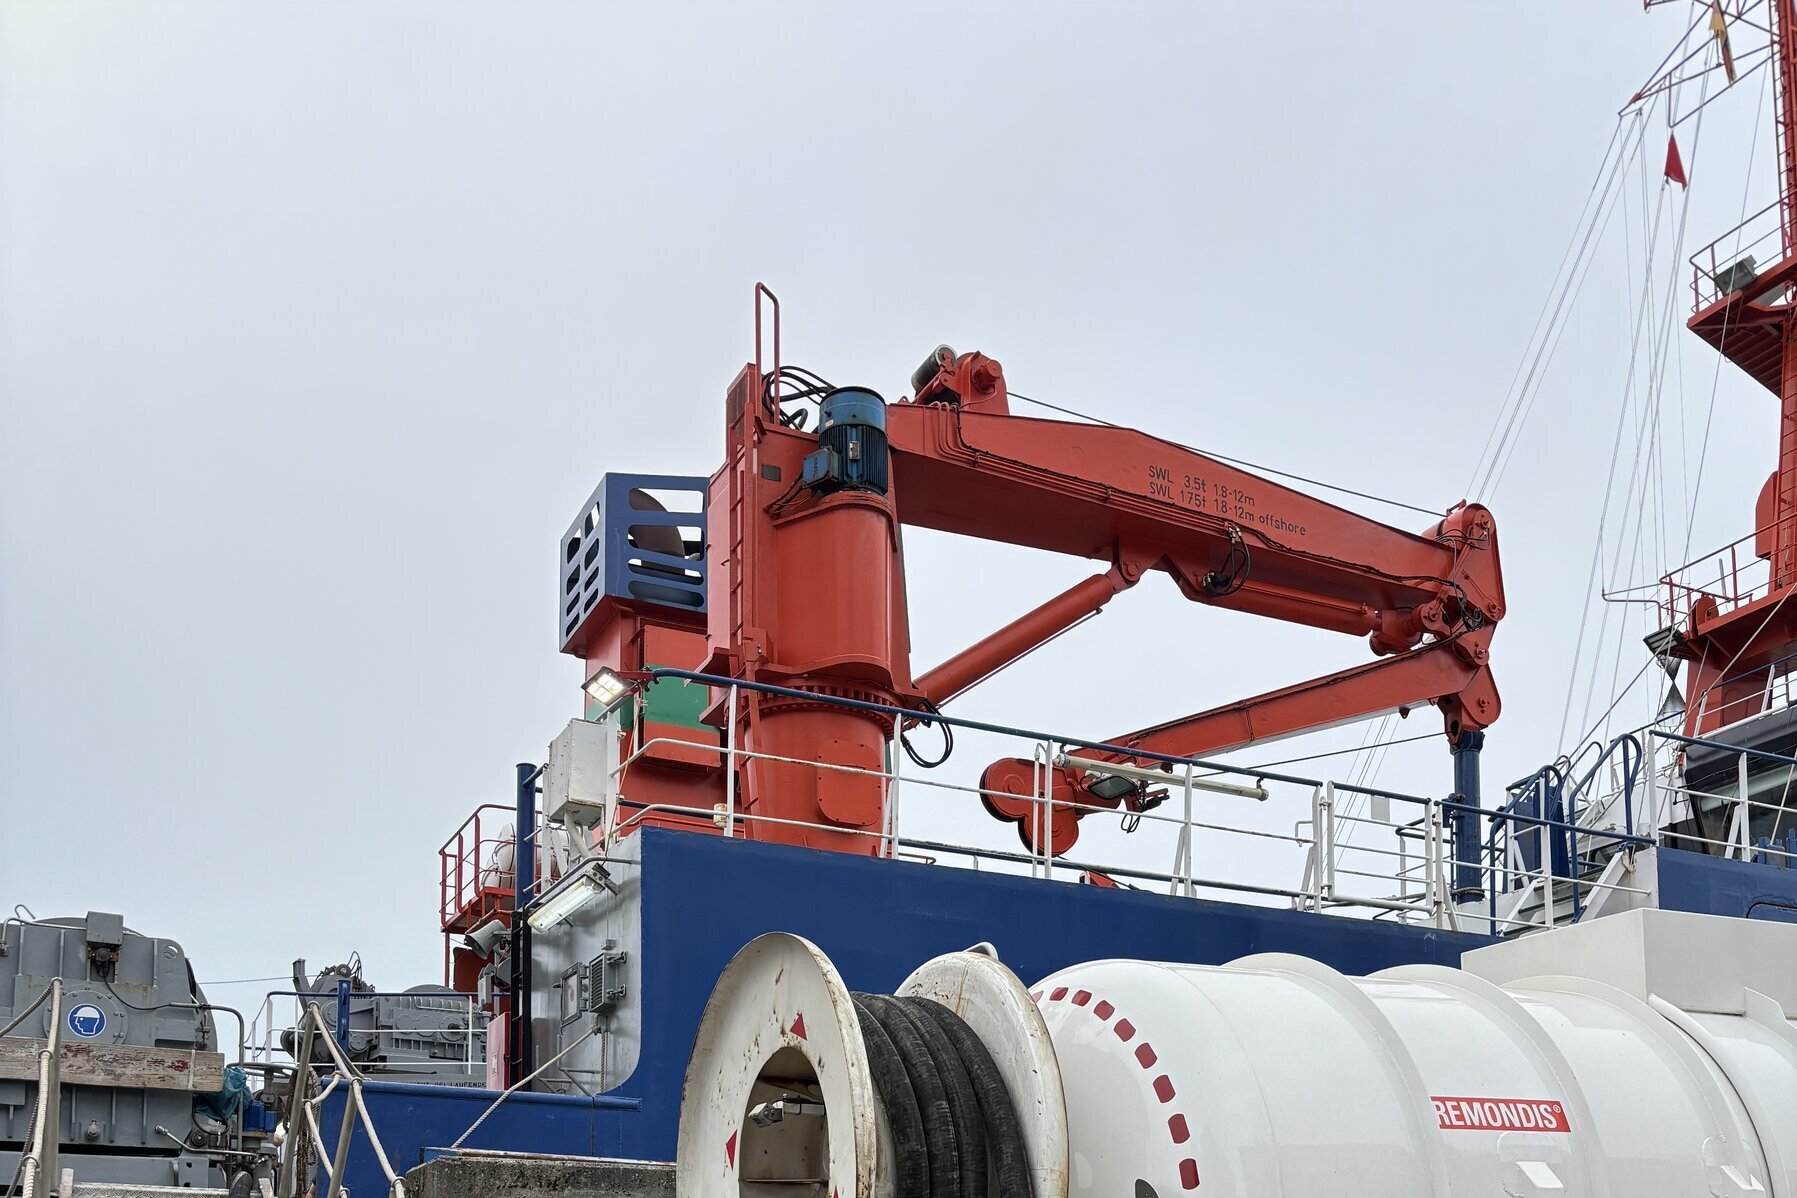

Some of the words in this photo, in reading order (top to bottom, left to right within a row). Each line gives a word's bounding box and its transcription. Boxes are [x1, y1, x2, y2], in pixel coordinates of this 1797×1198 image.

[1148, 464, 1174, 484] SWL
[1183, 474, 1207, 493] 3.5t
[1213, 483, 1255, 507] 1.8-12m
[1149, 481, 1174, 500] SWL
[1213, 498, 1255, 522] 1.8-12m
[1258, 514, 1307, 536] offshore
[1431, 1100, 1558, 1129] REMONDIS
